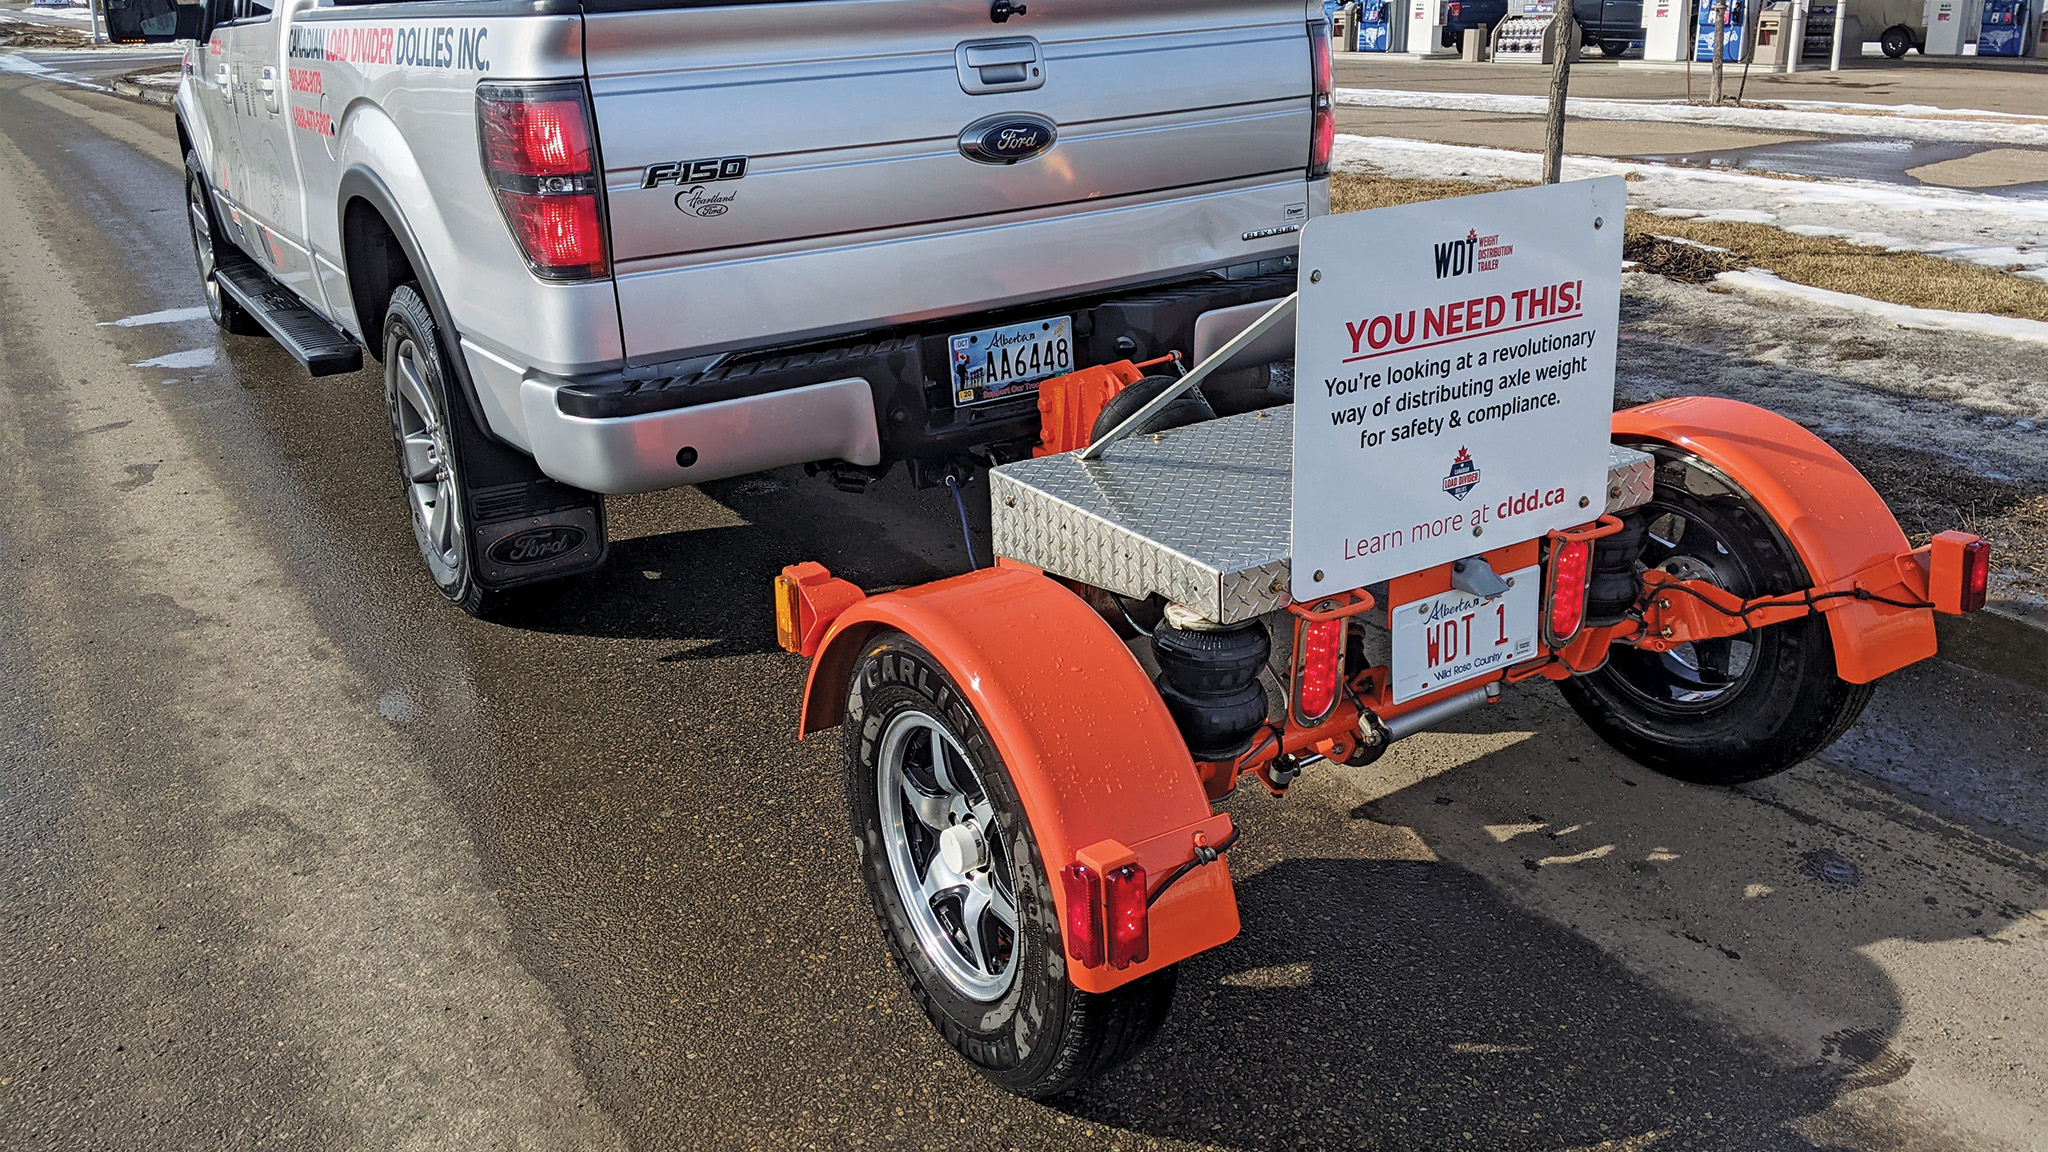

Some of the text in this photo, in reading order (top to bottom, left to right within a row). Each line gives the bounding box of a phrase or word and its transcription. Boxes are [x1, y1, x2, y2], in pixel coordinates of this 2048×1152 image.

[288, 27, 490, 71] CANADIAN LOAD DIVIDER DOLLIES INC.
[997, 128, 1038, 150] Ford
[641, 155, 749, 189] F-150
[687, 190, 737, 208] Heartland
[702, 206, 724, 216] Ford
[1478, 234, 1499, 247] WEIGHT
[1478, 245, 1513, 260] DISTRIBUTION
[1434, 237, 1477, 279] WDT
[1478, 259, 1499, 272] TRAILER
[1345, 280, 1583, 354] YOU NEED THIS!
[985, 331, 1029, 350] Alberta
[986, 338, 1069, 383] AA6448
[1325, 329, 1596, 397] You're looking at a revolutionary
[983, 387, 1010, 398] Support
[1011, 384, 1024, 393] Our
[1331, 356, 1587, 425] way of distributing axle weight
[1361, 392, 1560, 448] for safety & compliance.
[1445, 472, 1478, 489] LOAD DIVIDER
[1345, 487, 1565, 560] Learn more at cldd.ca
[510, 532, 567, 560] Ford
[1423, 598, 1474, 625] Alberta
[1427, 604, 1508, 669] WDT 1
[1434, 652, 1503, 681] Wild Rose Country
[864, 655, 1010, 808] CARLISLE
